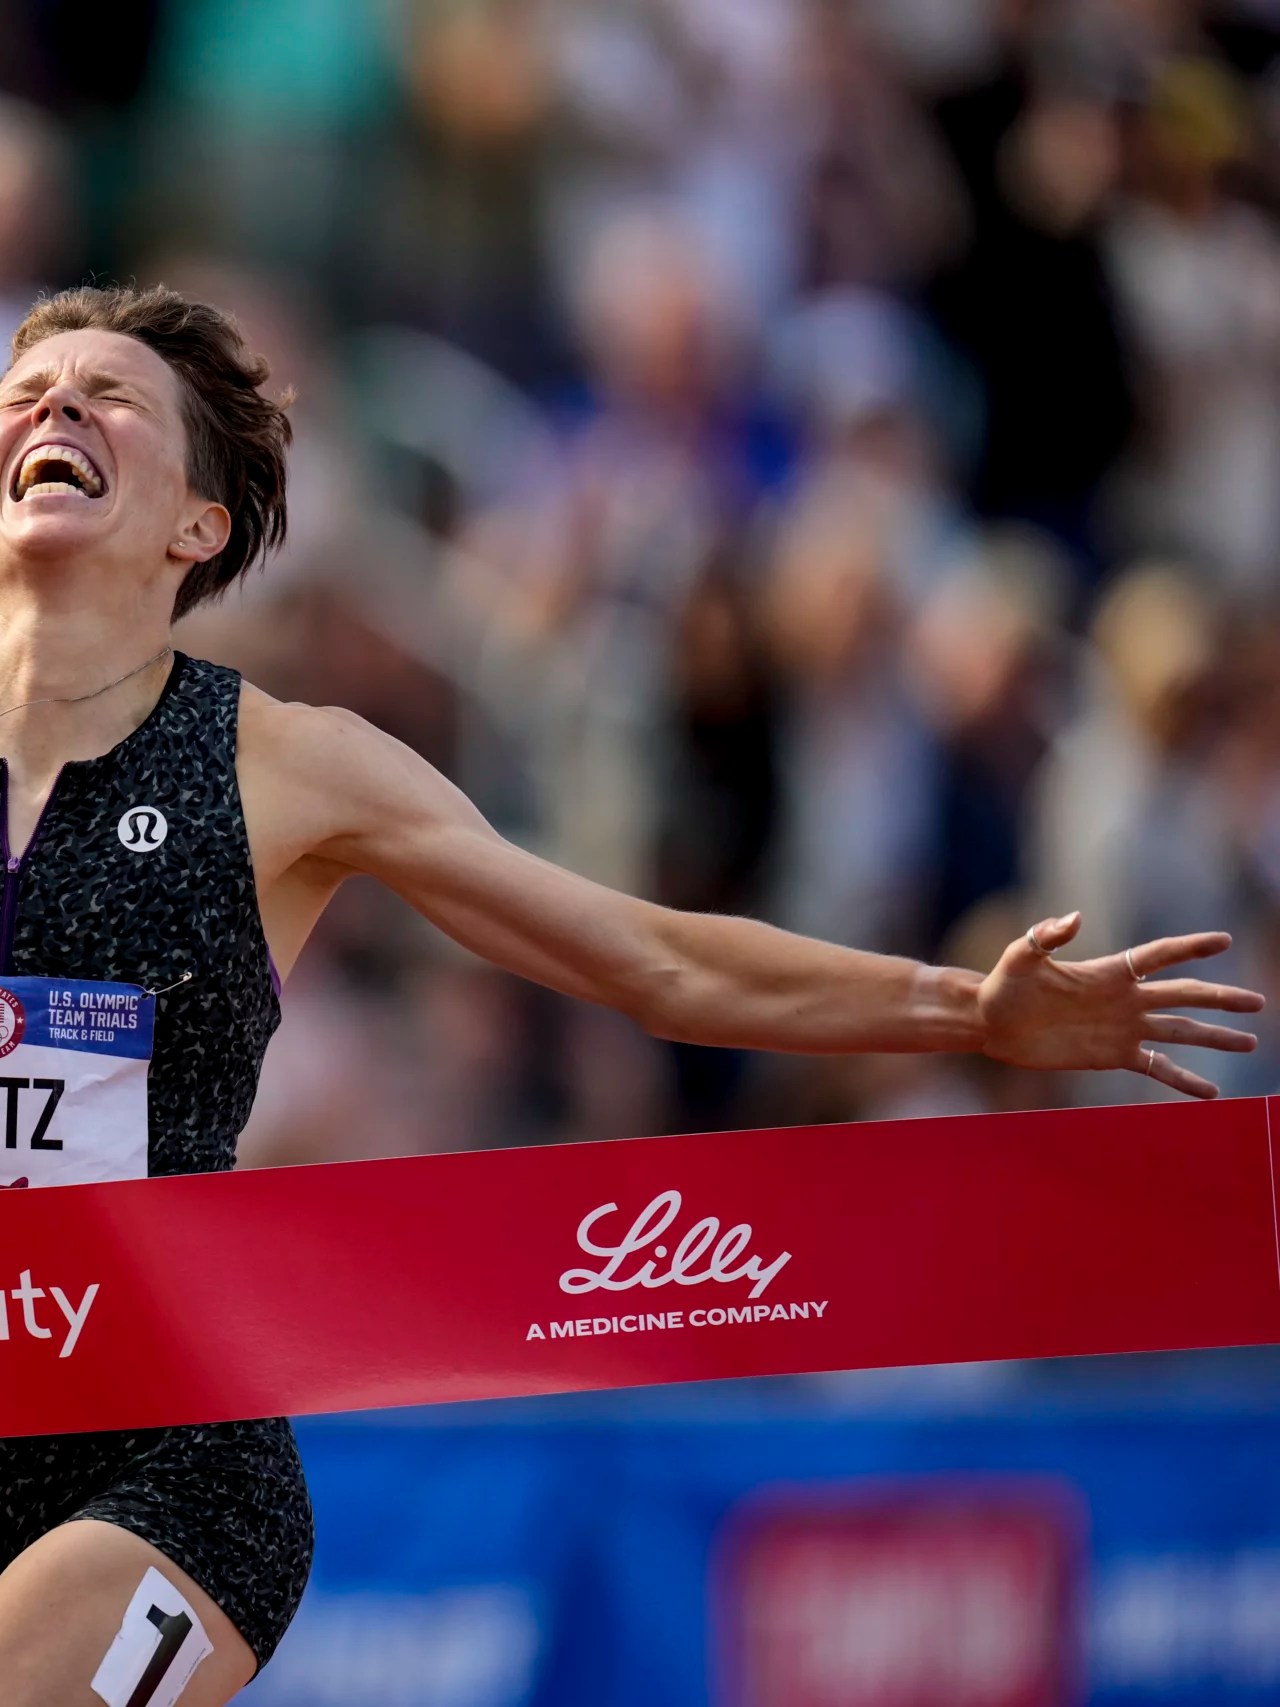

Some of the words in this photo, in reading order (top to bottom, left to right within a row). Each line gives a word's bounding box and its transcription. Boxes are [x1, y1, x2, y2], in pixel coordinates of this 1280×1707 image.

[49, 990, 75, 1008] U.S.
[80, 992, 139, 1011] OLYMPIC
[48, 1009, 85, 1026] TEAM
[89, 1011, 138, 1029] TRIALS
[49, 1027, 79, 1040] TRACK
[81, 1029, 88, 1041] &
[89, 1030, 115, 1042] FIELD
[559, 1190, 792, 1299] Lilly
[526, 1324, 546, 1341] A
[550, 1311, 684, 1339] MEDICINE
[689, 1301, 829, 1327] COMPANY
[125, 1603, 193, 1707] 1
